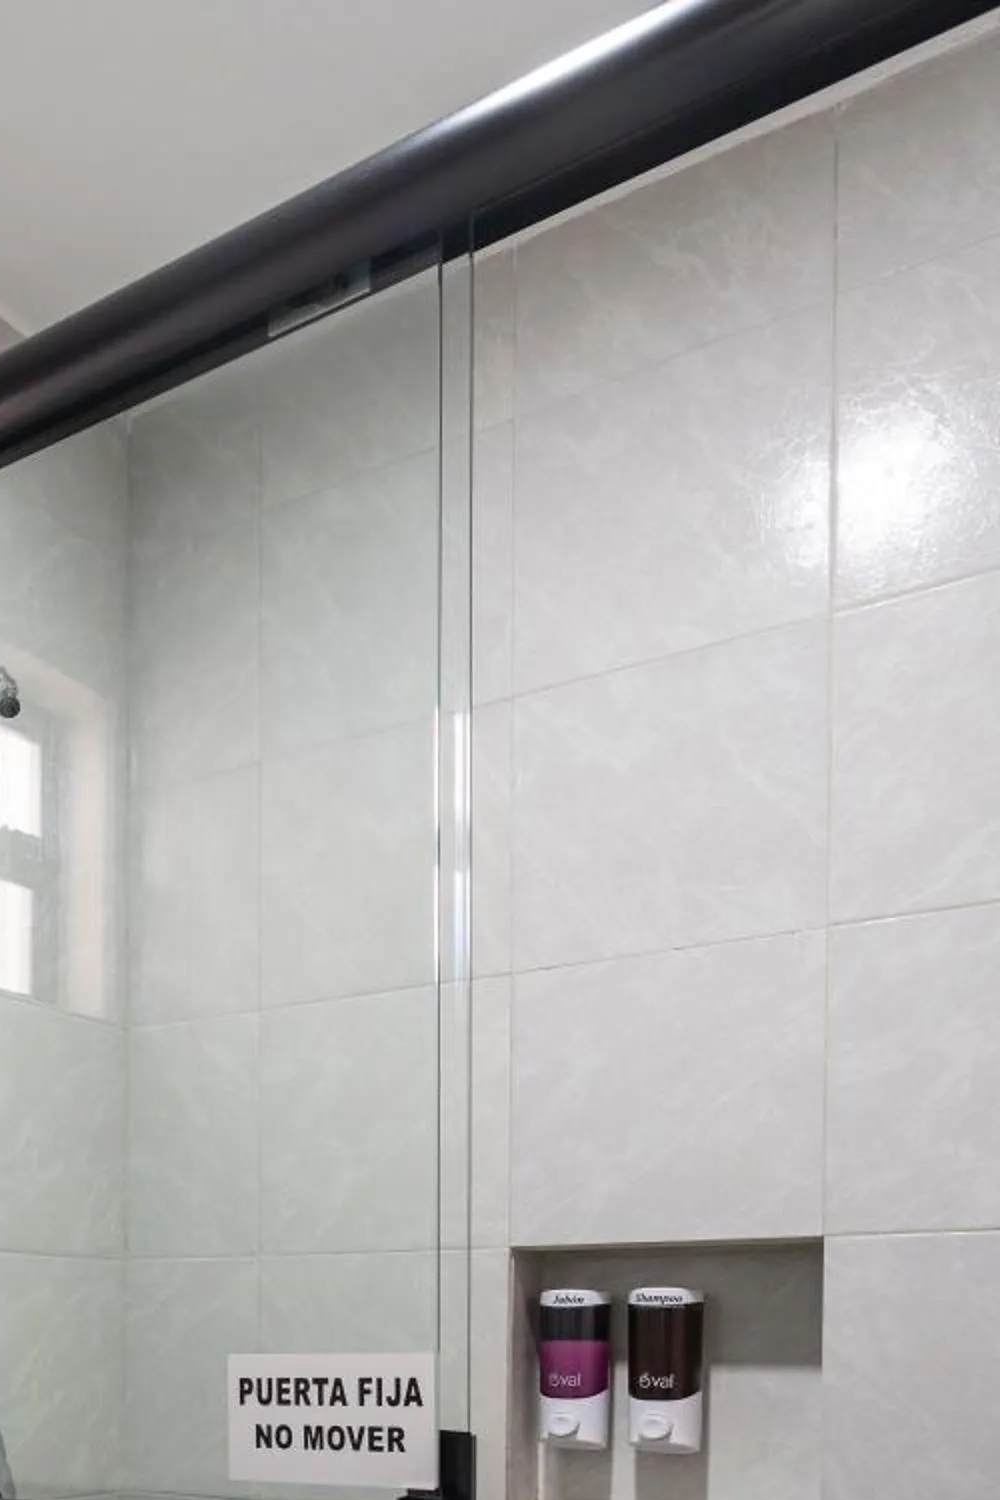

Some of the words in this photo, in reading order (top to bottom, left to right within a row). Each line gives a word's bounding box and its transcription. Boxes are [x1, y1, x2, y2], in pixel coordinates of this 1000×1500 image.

[239, 1377, 347, 1407] PUERTA
[358, 1377, 424, 1408] FIJA
[255, 1423, 292, 1450] NO
[303, 1424, 406, 1453] MOVER
